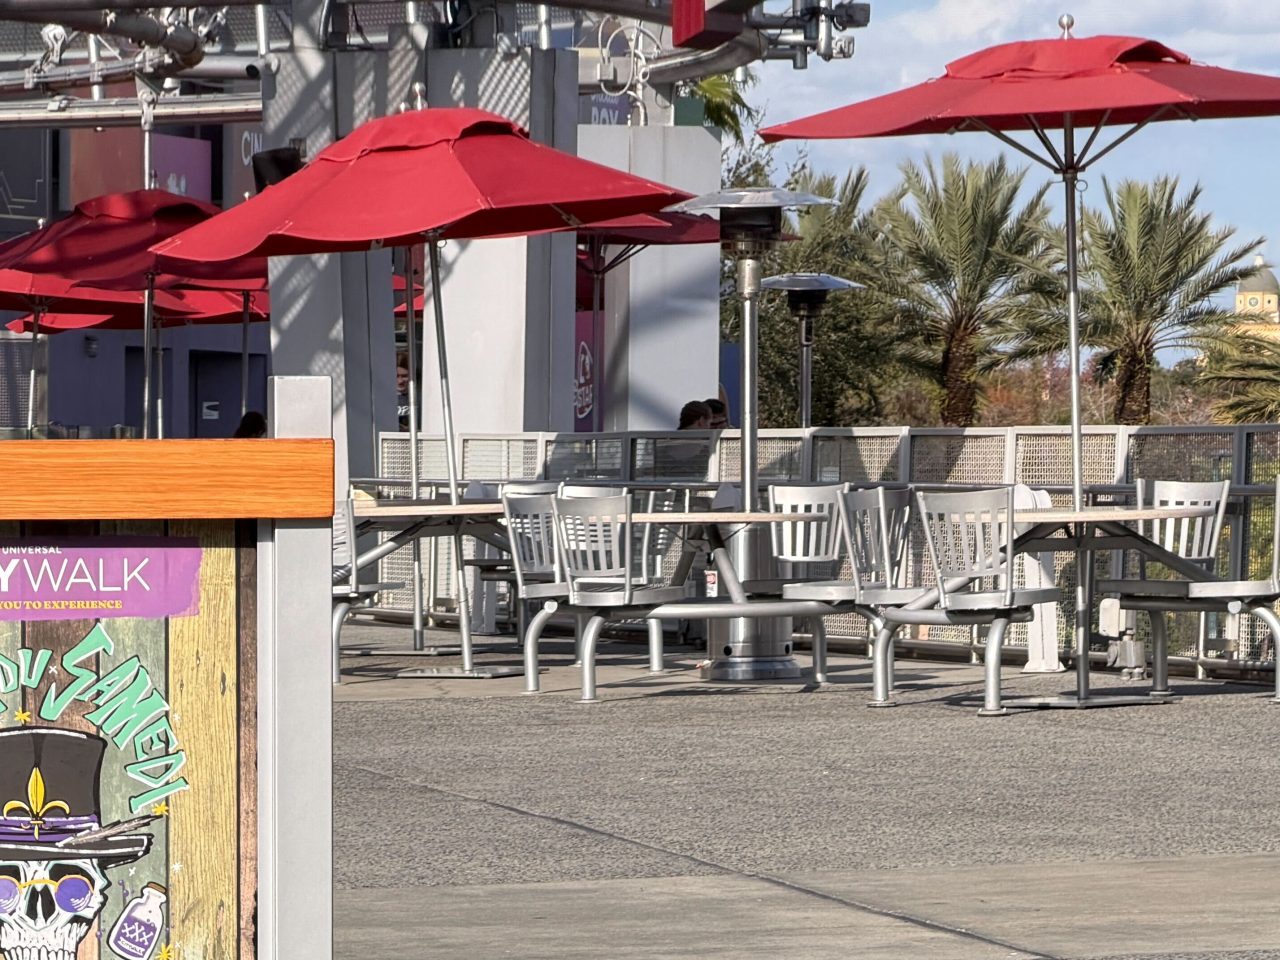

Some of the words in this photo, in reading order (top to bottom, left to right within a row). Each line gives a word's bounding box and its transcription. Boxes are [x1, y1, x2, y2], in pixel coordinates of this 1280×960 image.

[1, 546, 62, 555] UNIVERSAL
[23, 600, 42, 609] TO
[43, 599, 123, 610] EXPERIENCE
[37, 621, 191, 816] SAMEDI
